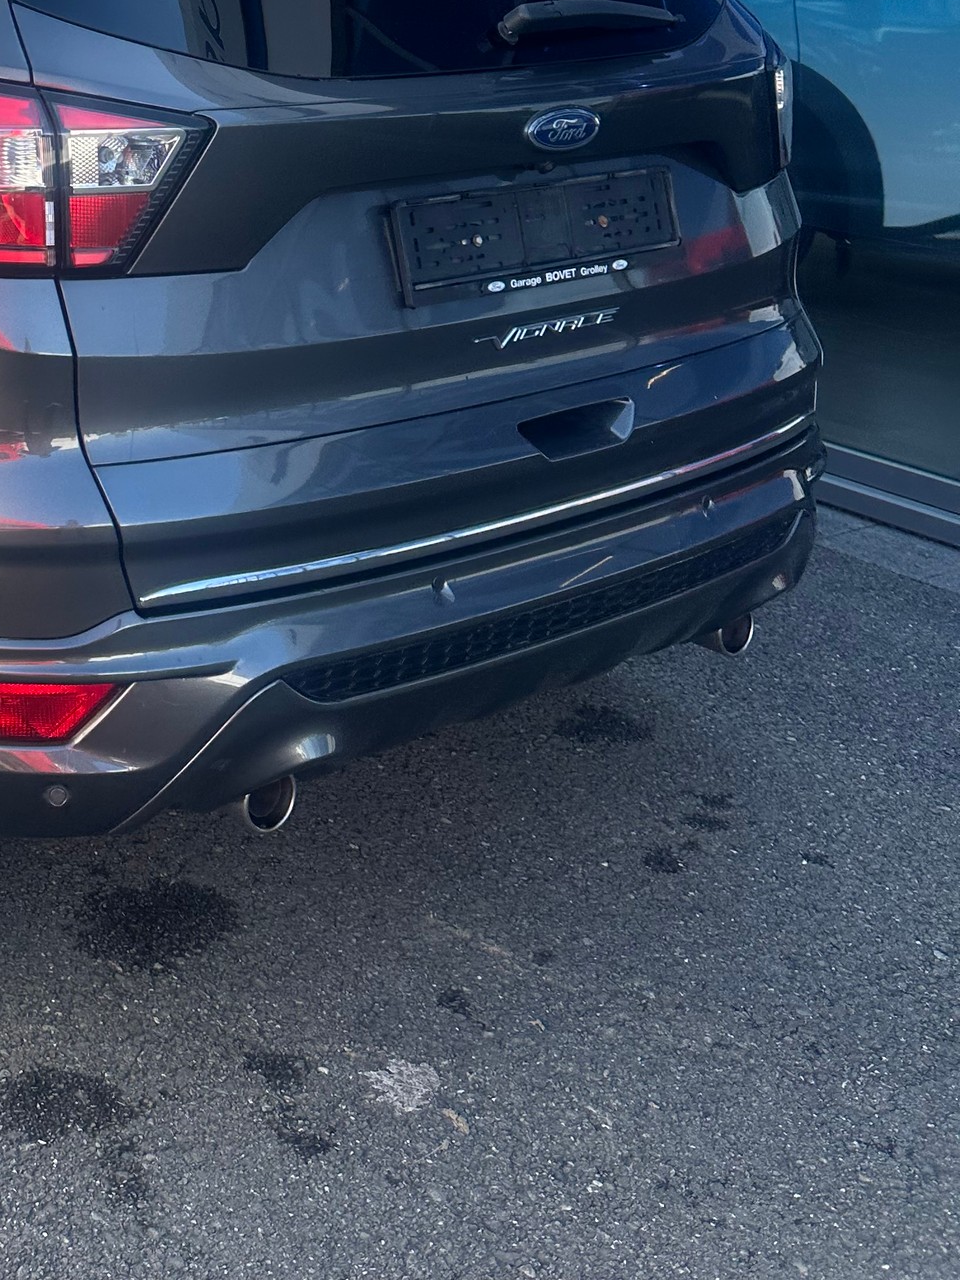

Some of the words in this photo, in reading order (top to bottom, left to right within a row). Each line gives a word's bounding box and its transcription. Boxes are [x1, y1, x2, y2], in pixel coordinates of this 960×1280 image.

[548, 119, 587, 143] Ford
[511, 276, 542, 289] Garage
[545, 268, 577, 282] BOVET
[580, 264, 608, 276] Grolley
[473, 306, 620, 349] VIGNALE
